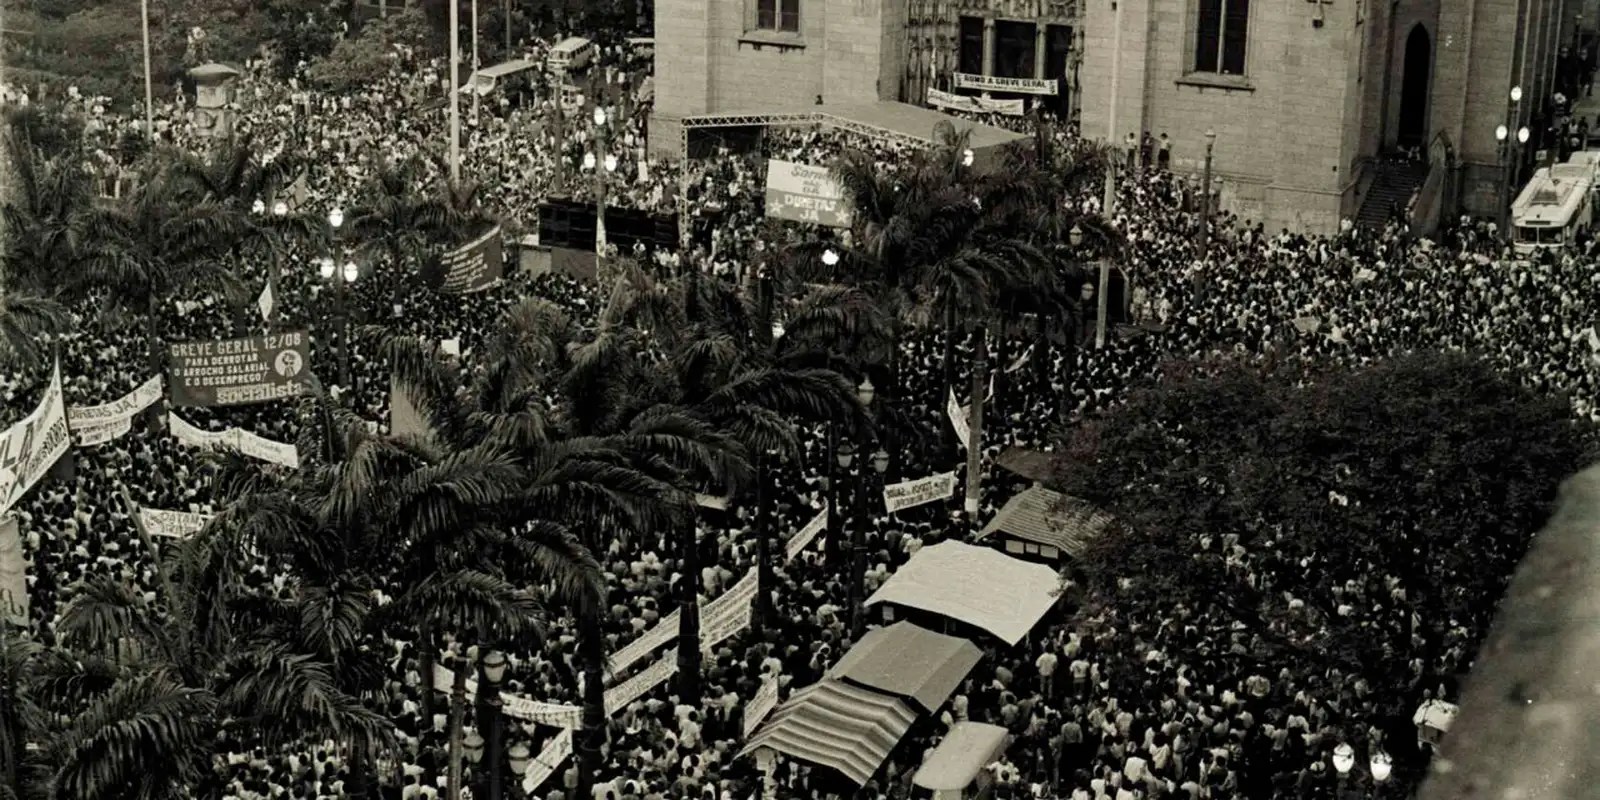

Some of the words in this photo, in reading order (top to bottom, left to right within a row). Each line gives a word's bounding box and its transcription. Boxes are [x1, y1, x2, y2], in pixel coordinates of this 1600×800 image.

[996, 77, 1019, 87] GREVE
[1022, 78, 1047, 89] GERAL
[171, 342, 213, 357] GREVE
[217, 339, 259, 355] GERAL
[185, 357, 209, 367] PARA
[211, 353, 258, 366] DERROTAR
[174, 368, 181, 377] O
[183, 365, 224, 377] ARROCHO
[227, 361, 271, 374] SALARIAL
[185, 377, 191, 387] E
[194, 376, 200, 386] O
